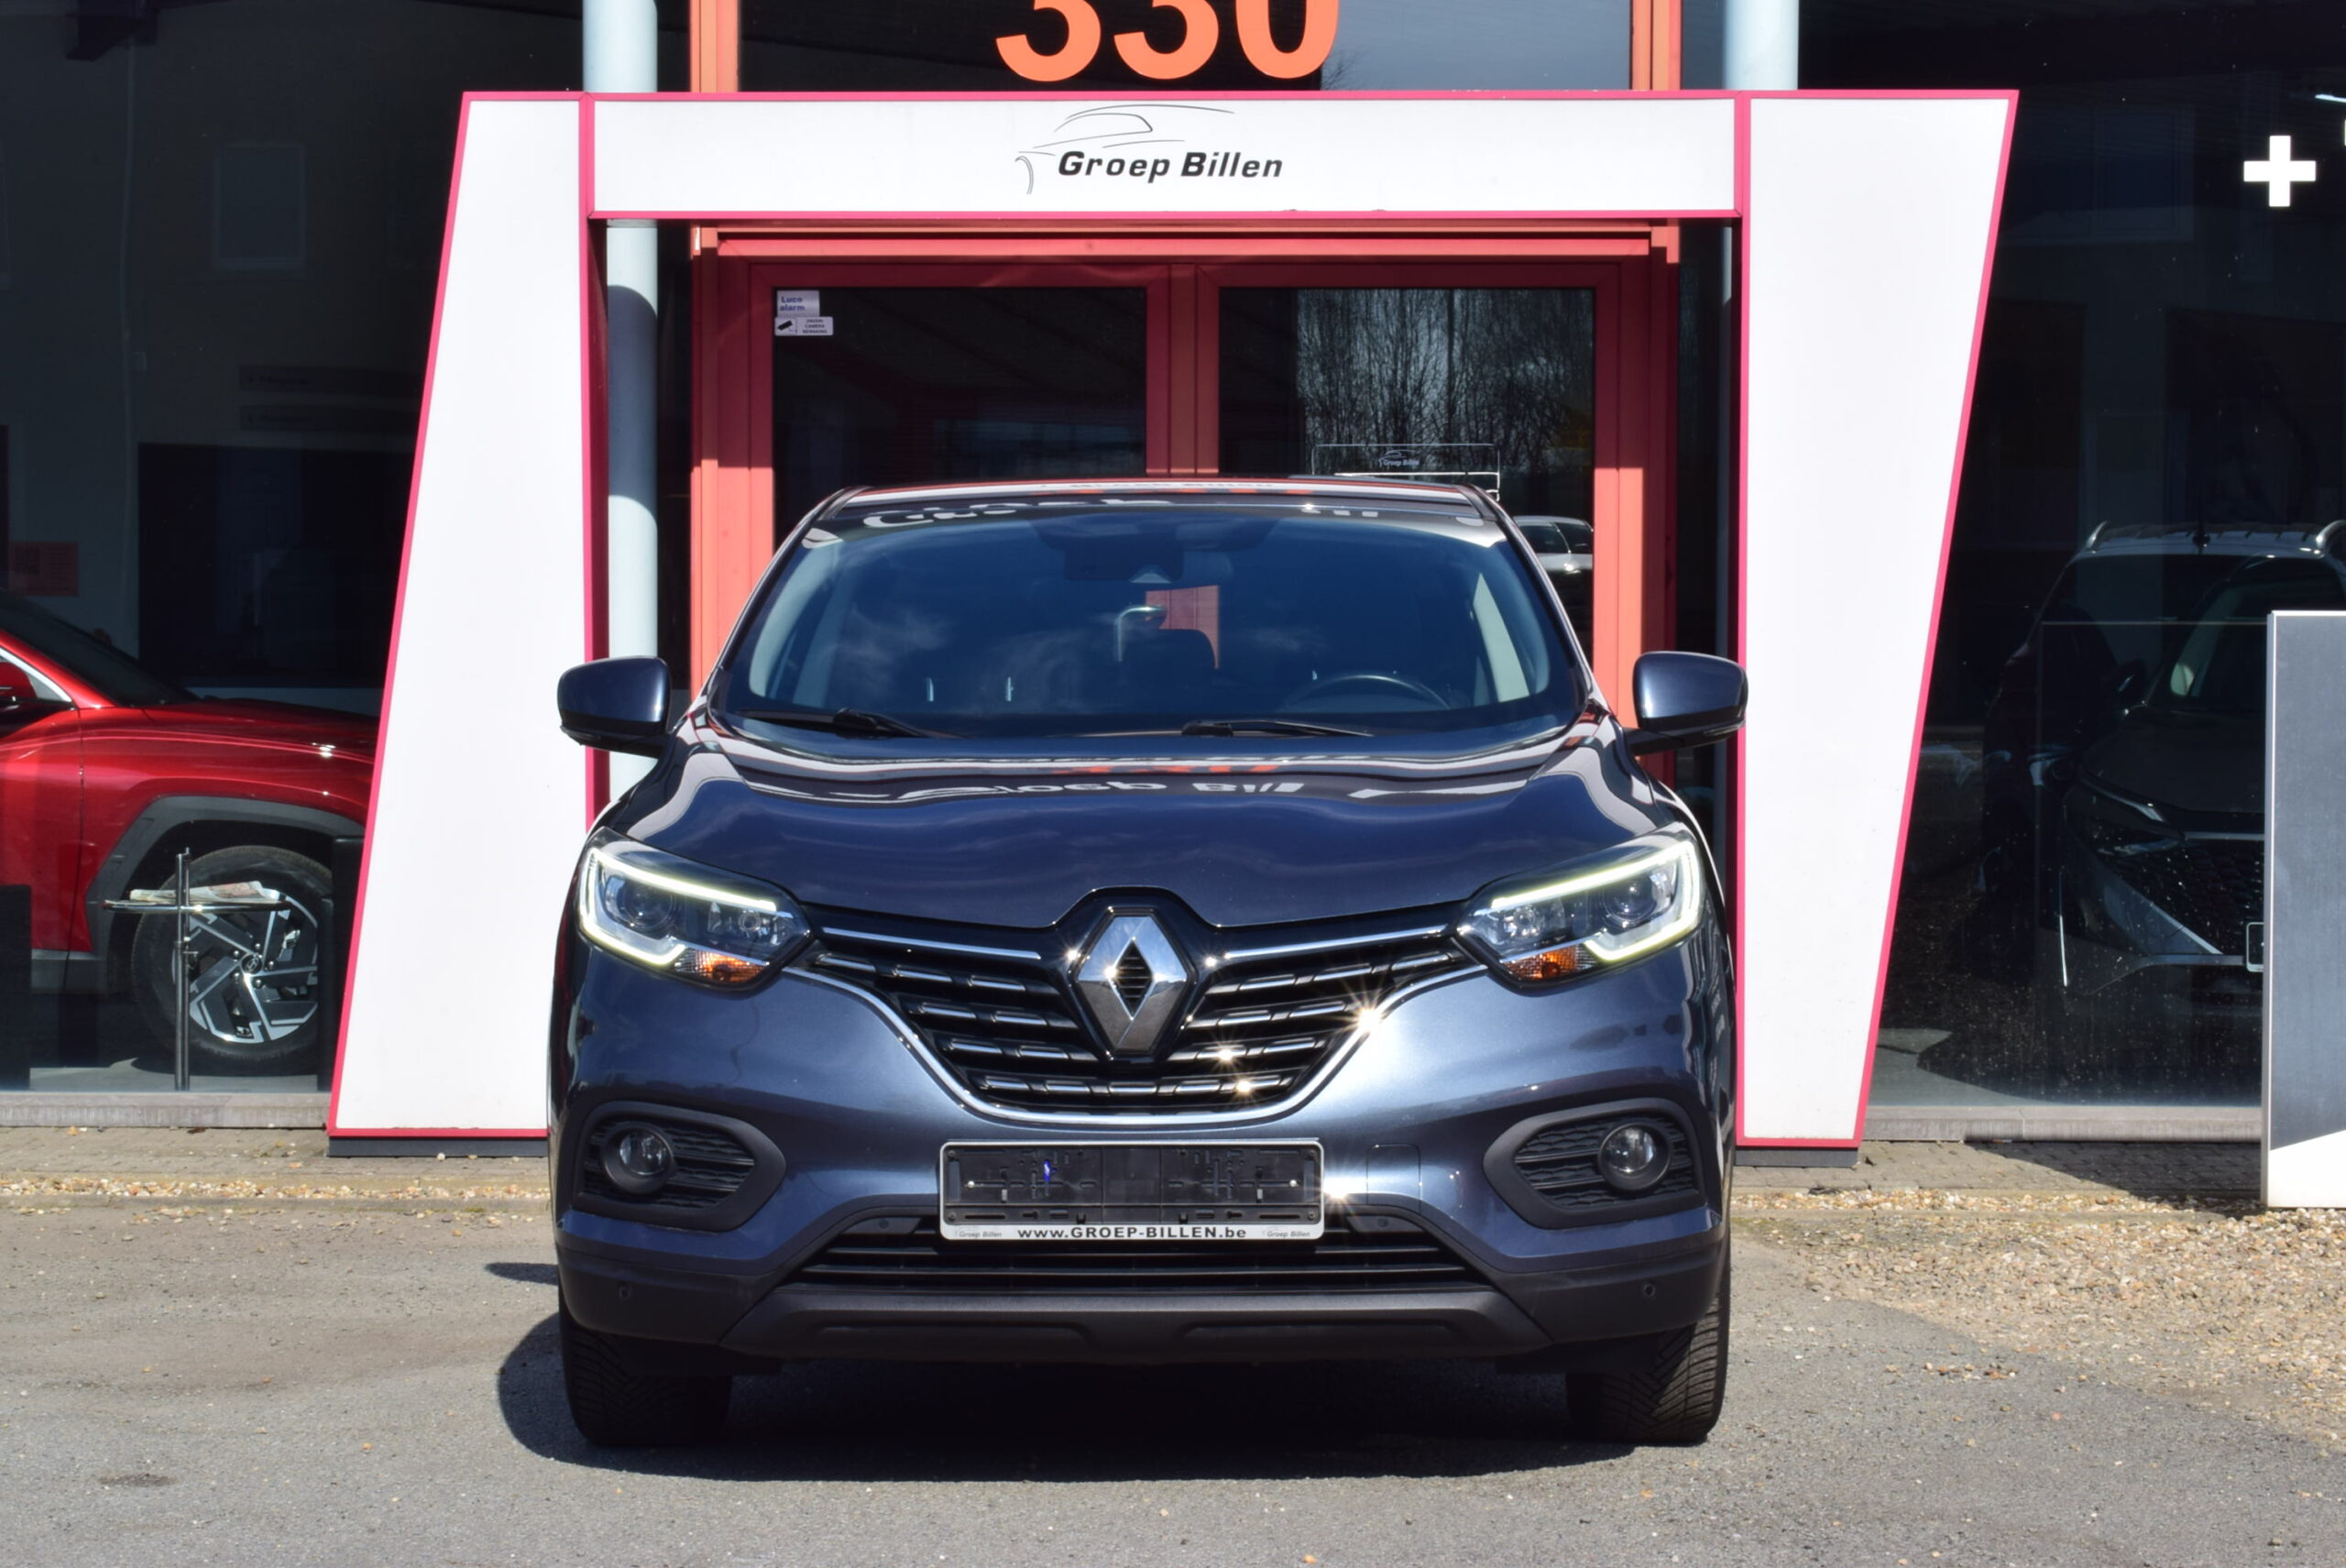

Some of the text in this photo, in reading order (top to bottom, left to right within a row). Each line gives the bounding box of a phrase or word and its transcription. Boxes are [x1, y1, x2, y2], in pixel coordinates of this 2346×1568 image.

[1058, 150, 1283, 183] Groep Billen
[1017, 1226, 1247, 1239] www.GROEP-BILLEN.be
